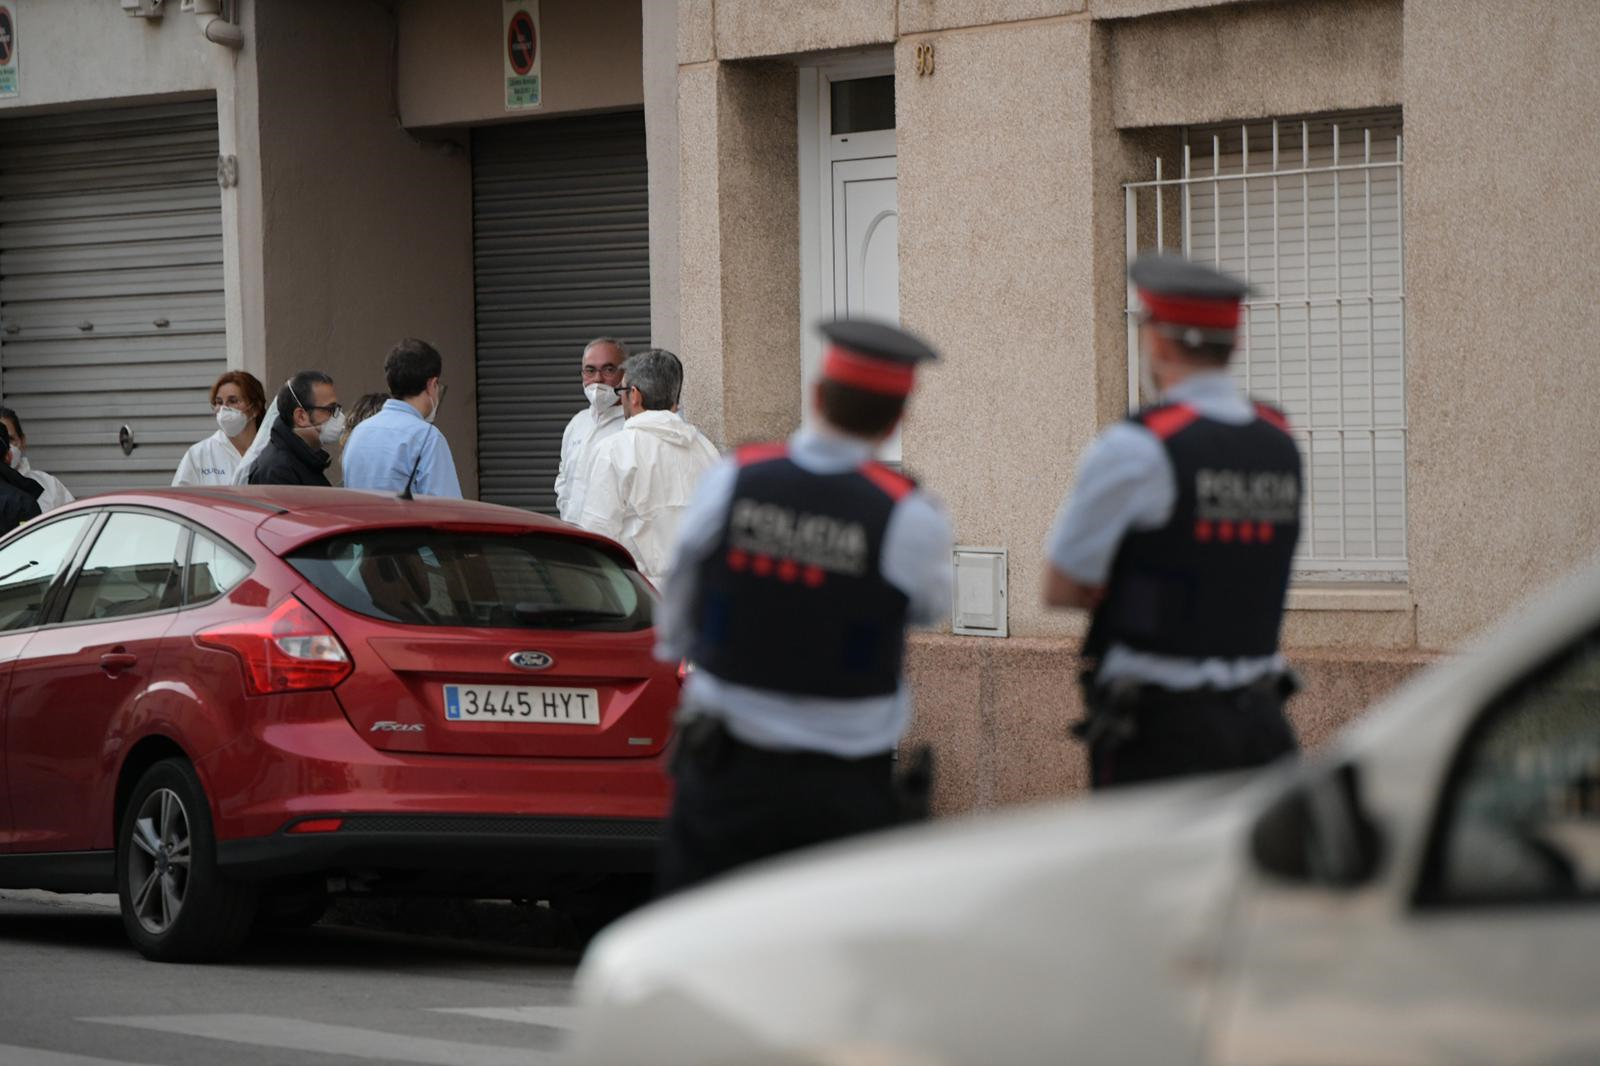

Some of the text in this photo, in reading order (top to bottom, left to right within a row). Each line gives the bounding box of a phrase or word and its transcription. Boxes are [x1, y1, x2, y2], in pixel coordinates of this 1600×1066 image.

[1196, 469, 1297, 502] POLICIA
[732, 499, 866, 552] POLICIA
[464, 690, 532, 717] 3445
[541, 692, 590, 719] HYT
